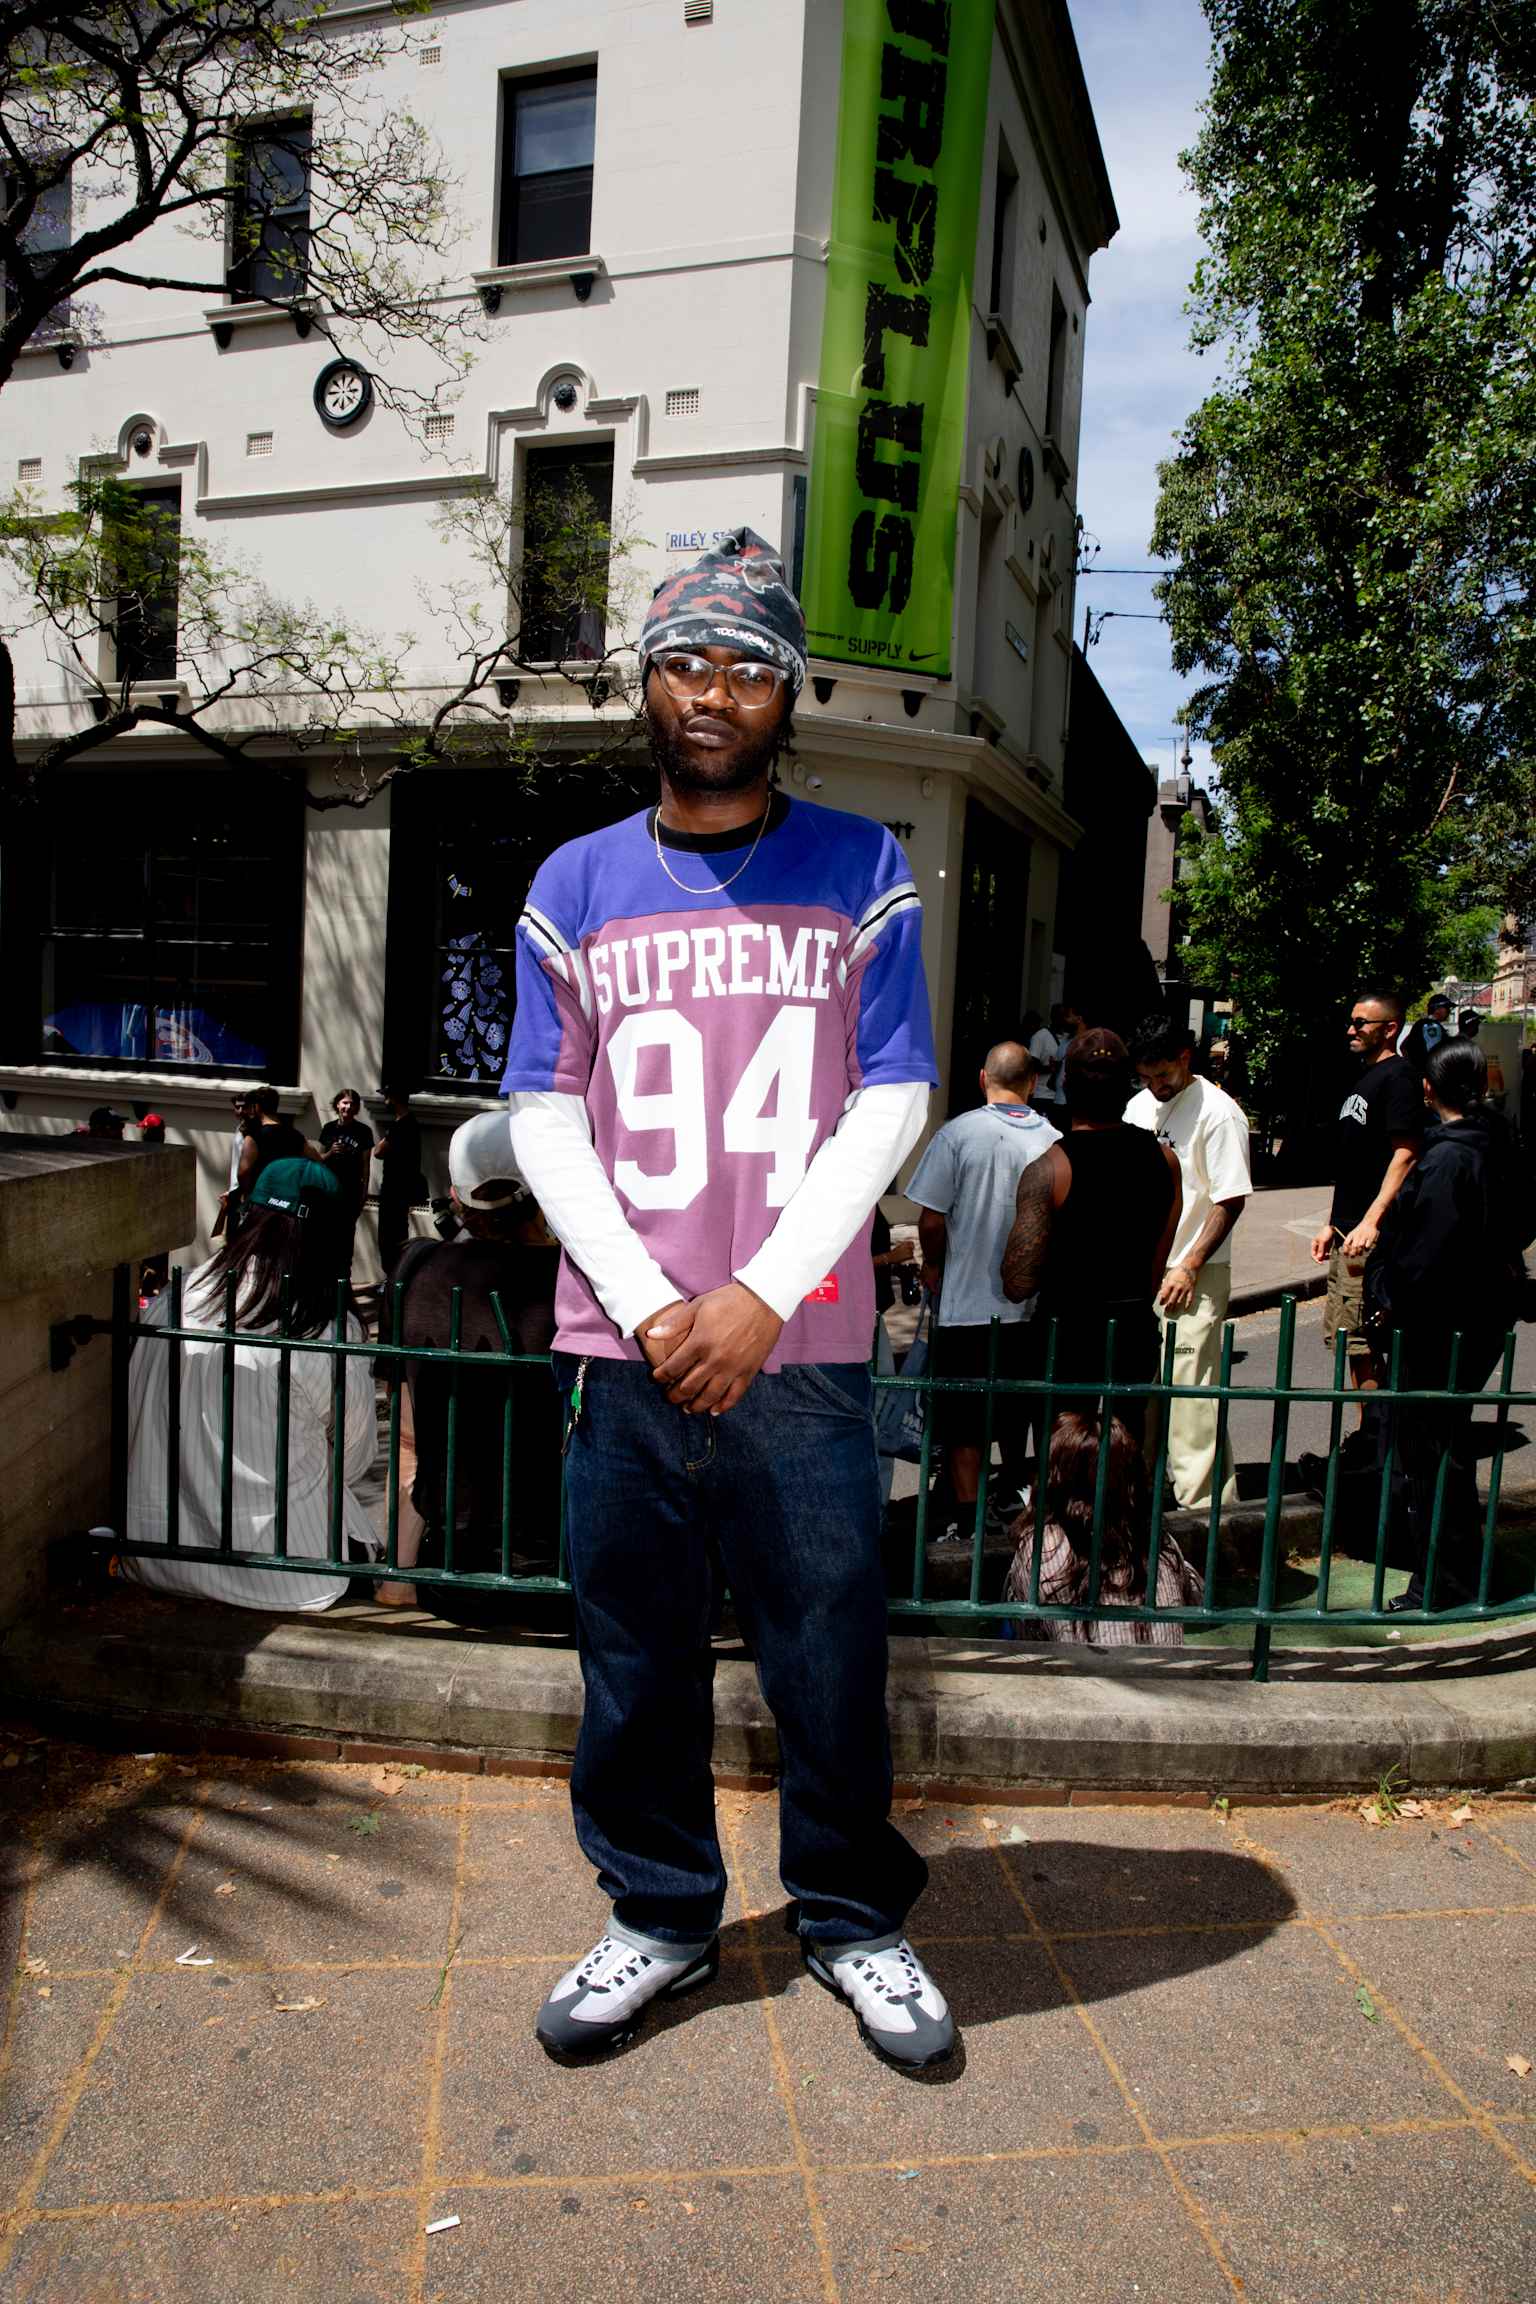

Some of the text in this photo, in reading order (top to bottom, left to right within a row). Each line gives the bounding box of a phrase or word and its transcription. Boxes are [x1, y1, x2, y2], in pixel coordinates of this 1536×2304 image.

[670, 533, 706, 548] RILEY
[848, 636, 903, 659] SUPPLY
[590, 923, 839, 1014] SUPREME
[606, 1005, 818, 1210] 94
